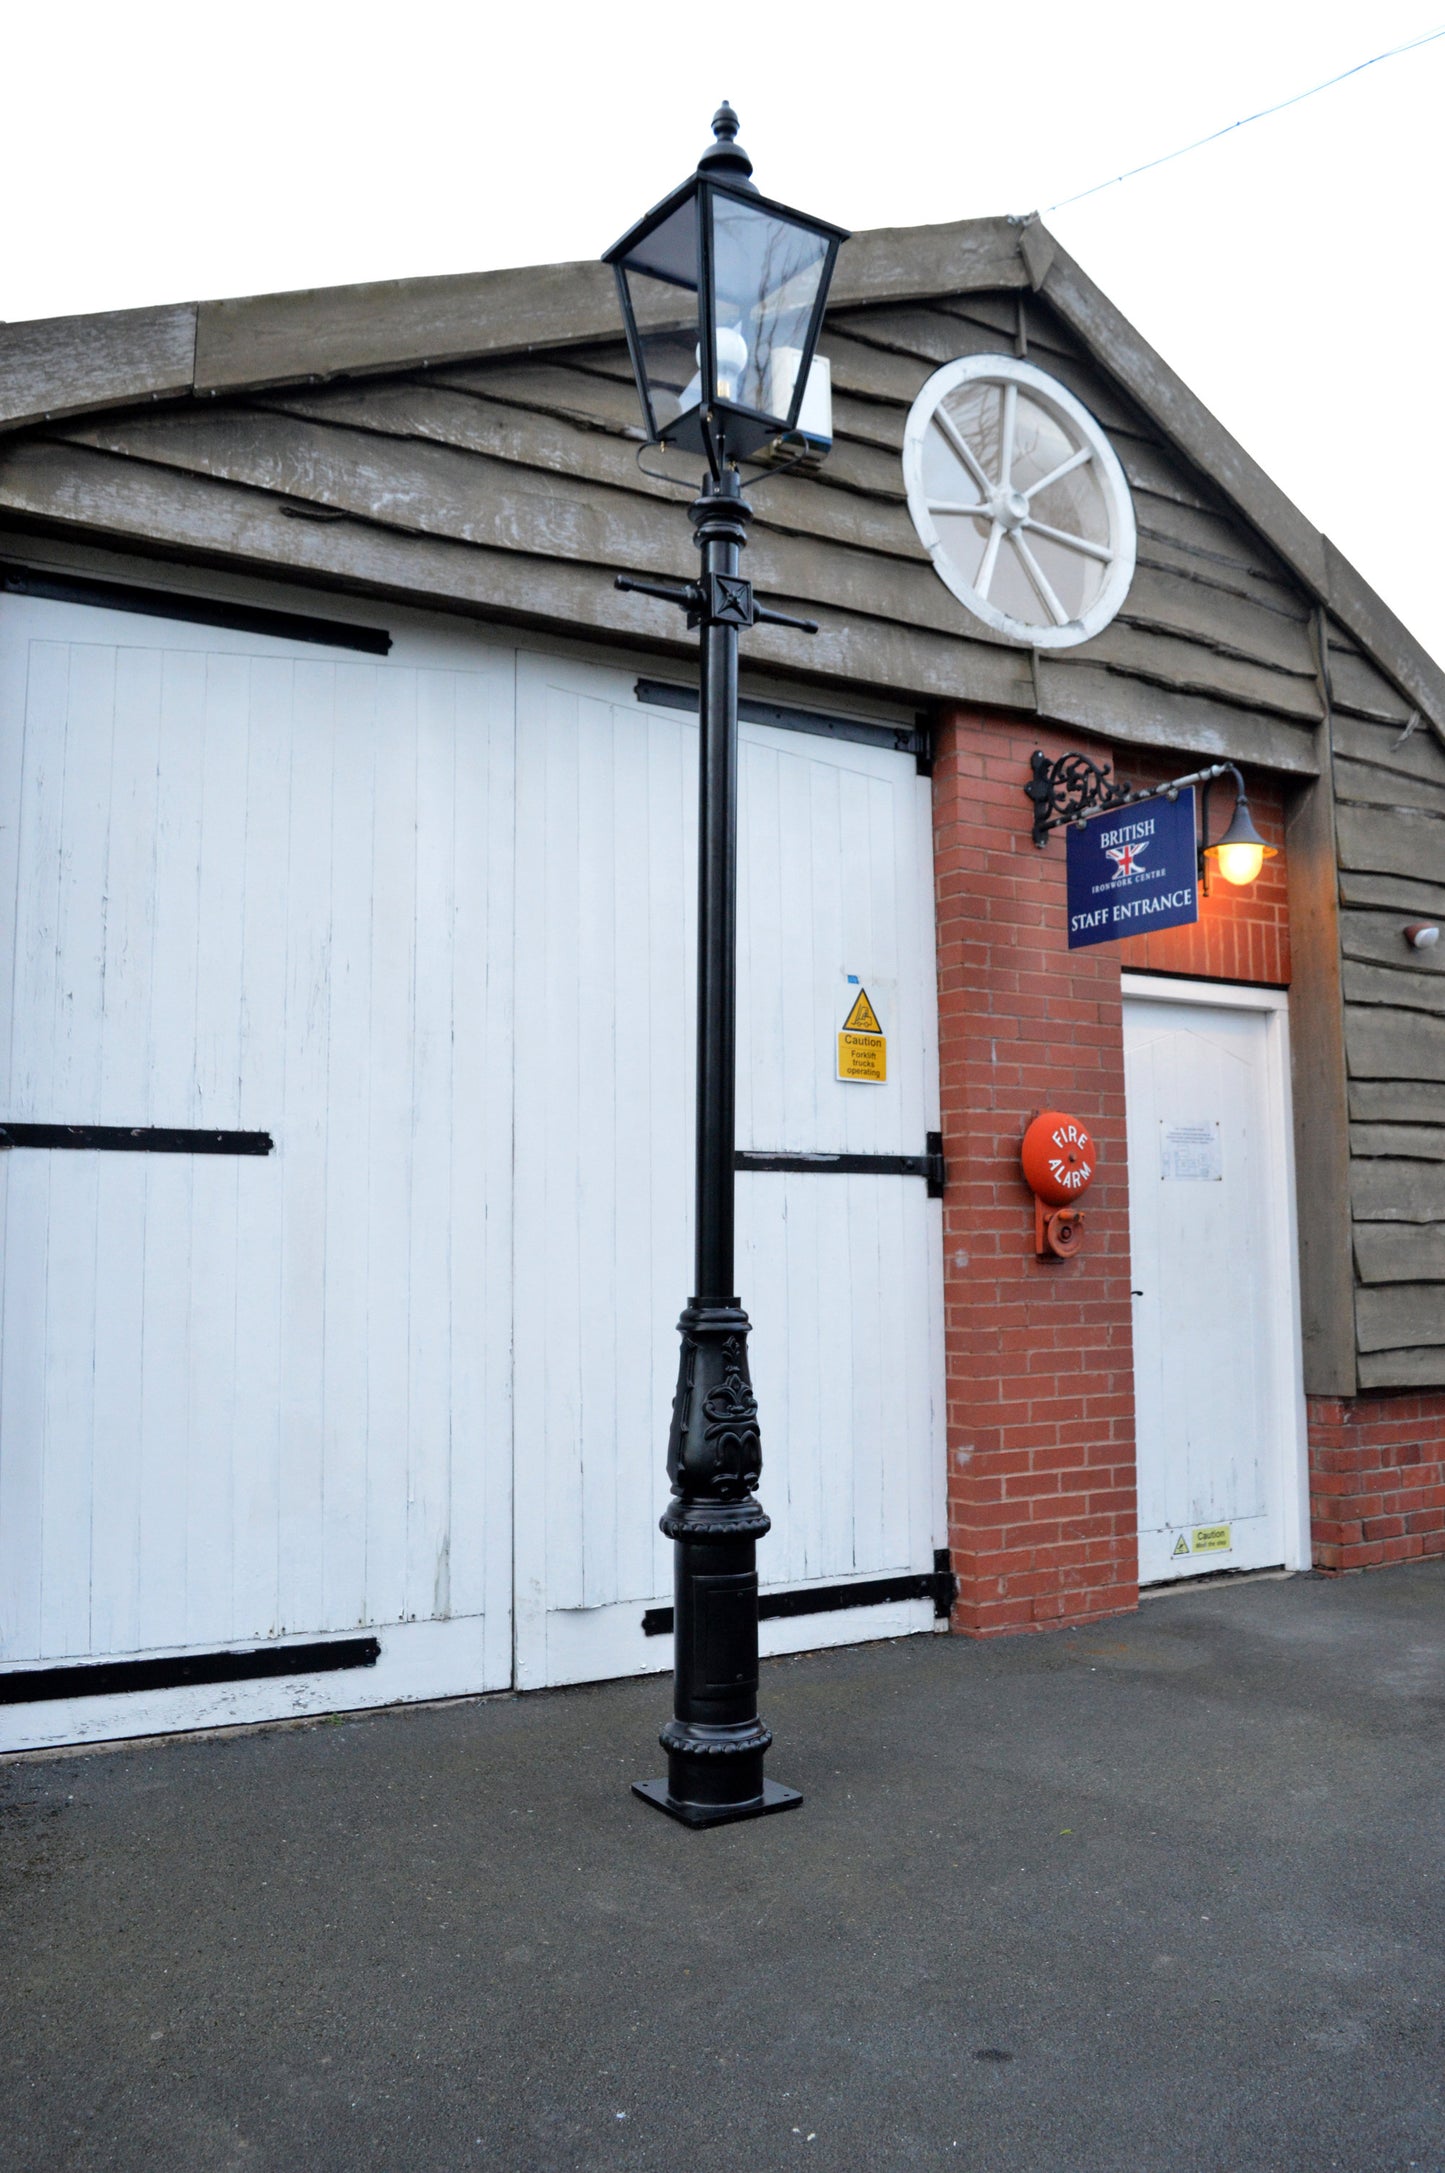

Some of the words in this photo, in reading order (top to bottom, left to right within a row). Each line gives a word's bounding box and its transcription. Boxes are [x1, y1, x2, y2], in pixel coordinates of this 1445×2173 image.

[1101, 818, 1155, 848] BRITISH
[1092, 877, 1132, 894] IRONWORK
[1135, 868, 1166, 883] CENTRE
[1071, 908, 1109, 932] STAFF
[1113, 888, 1192, 922] ENTRANCE
[844, 1034, 882, 1047] Caution
[851, 1050, 876, 1060] Forklift
[852, 1059, 875, 1068] trucks
[847, 1067, 880, 1078] operating
[1052, 1125, 1088, 1149] FIRE
[1048, 1159, 1091, 1188] ALARM
